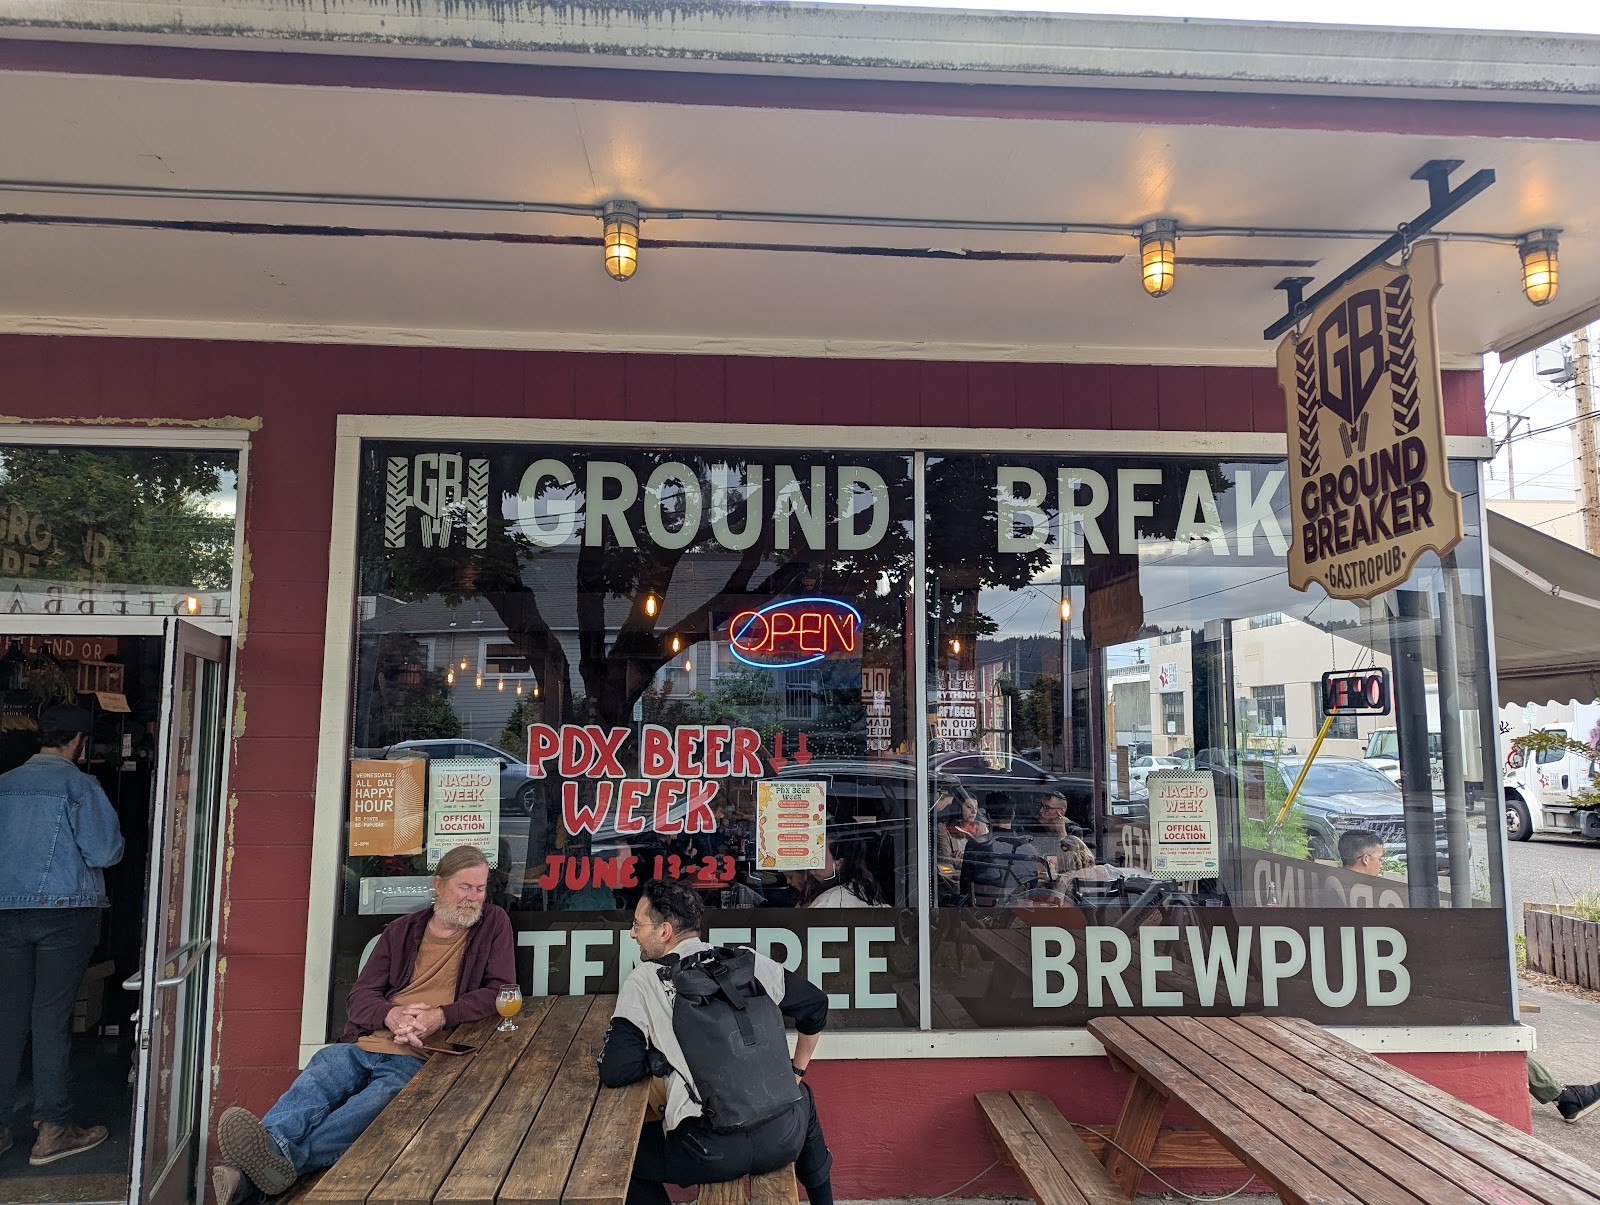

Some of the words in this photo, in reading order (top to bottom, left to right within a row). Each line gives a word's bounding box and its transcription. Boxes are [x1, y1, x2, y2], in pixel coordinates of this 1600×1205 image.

[1301, 436, 1428, 523] GROUND
[517, 459, 890, 550] GROUND
[997, 466, 1291, 556] BREAK
[1303, 481, 1434, 565] BREAKER
[1329, 545, 1402, 589] GASTROPUB
[730, 611, 854, 652] OPEN
[937, 670, 976, 681] UTEN
[937, 691, 977, 700] RYTHING
[952, 719, 976, 728] OUR
[527, 724, 632, 778] PDX
[641, 724, 764, 778] BEER
[356, 779, 372, 787] ALL
[378, 779, 395, 787] DAY
[437, 773, 492, 787] NACHO
[355, 788, 394, 799] HAPPY
[441, 788, 485, 803] WEEK
[1159, 784, 1208, 799] NACHO
[354, 800, 394, 812] HOUR
[562, 778, 719, 836] WEEK
[1163, 799, 1204, 813] WEEK
[442, 814, 483, 823] OFFICIAL
[440, 823, 485, 831] LOCATION
[1166, 824, 1204, 832] OFFICIAL
[1164, 832, 1206, 840] LOCATION
[539, 854, 638, 890] JUNE
[653, 854, 736, 881] 13-23
[1030, 926, 1411, 1007] BREWPUB
